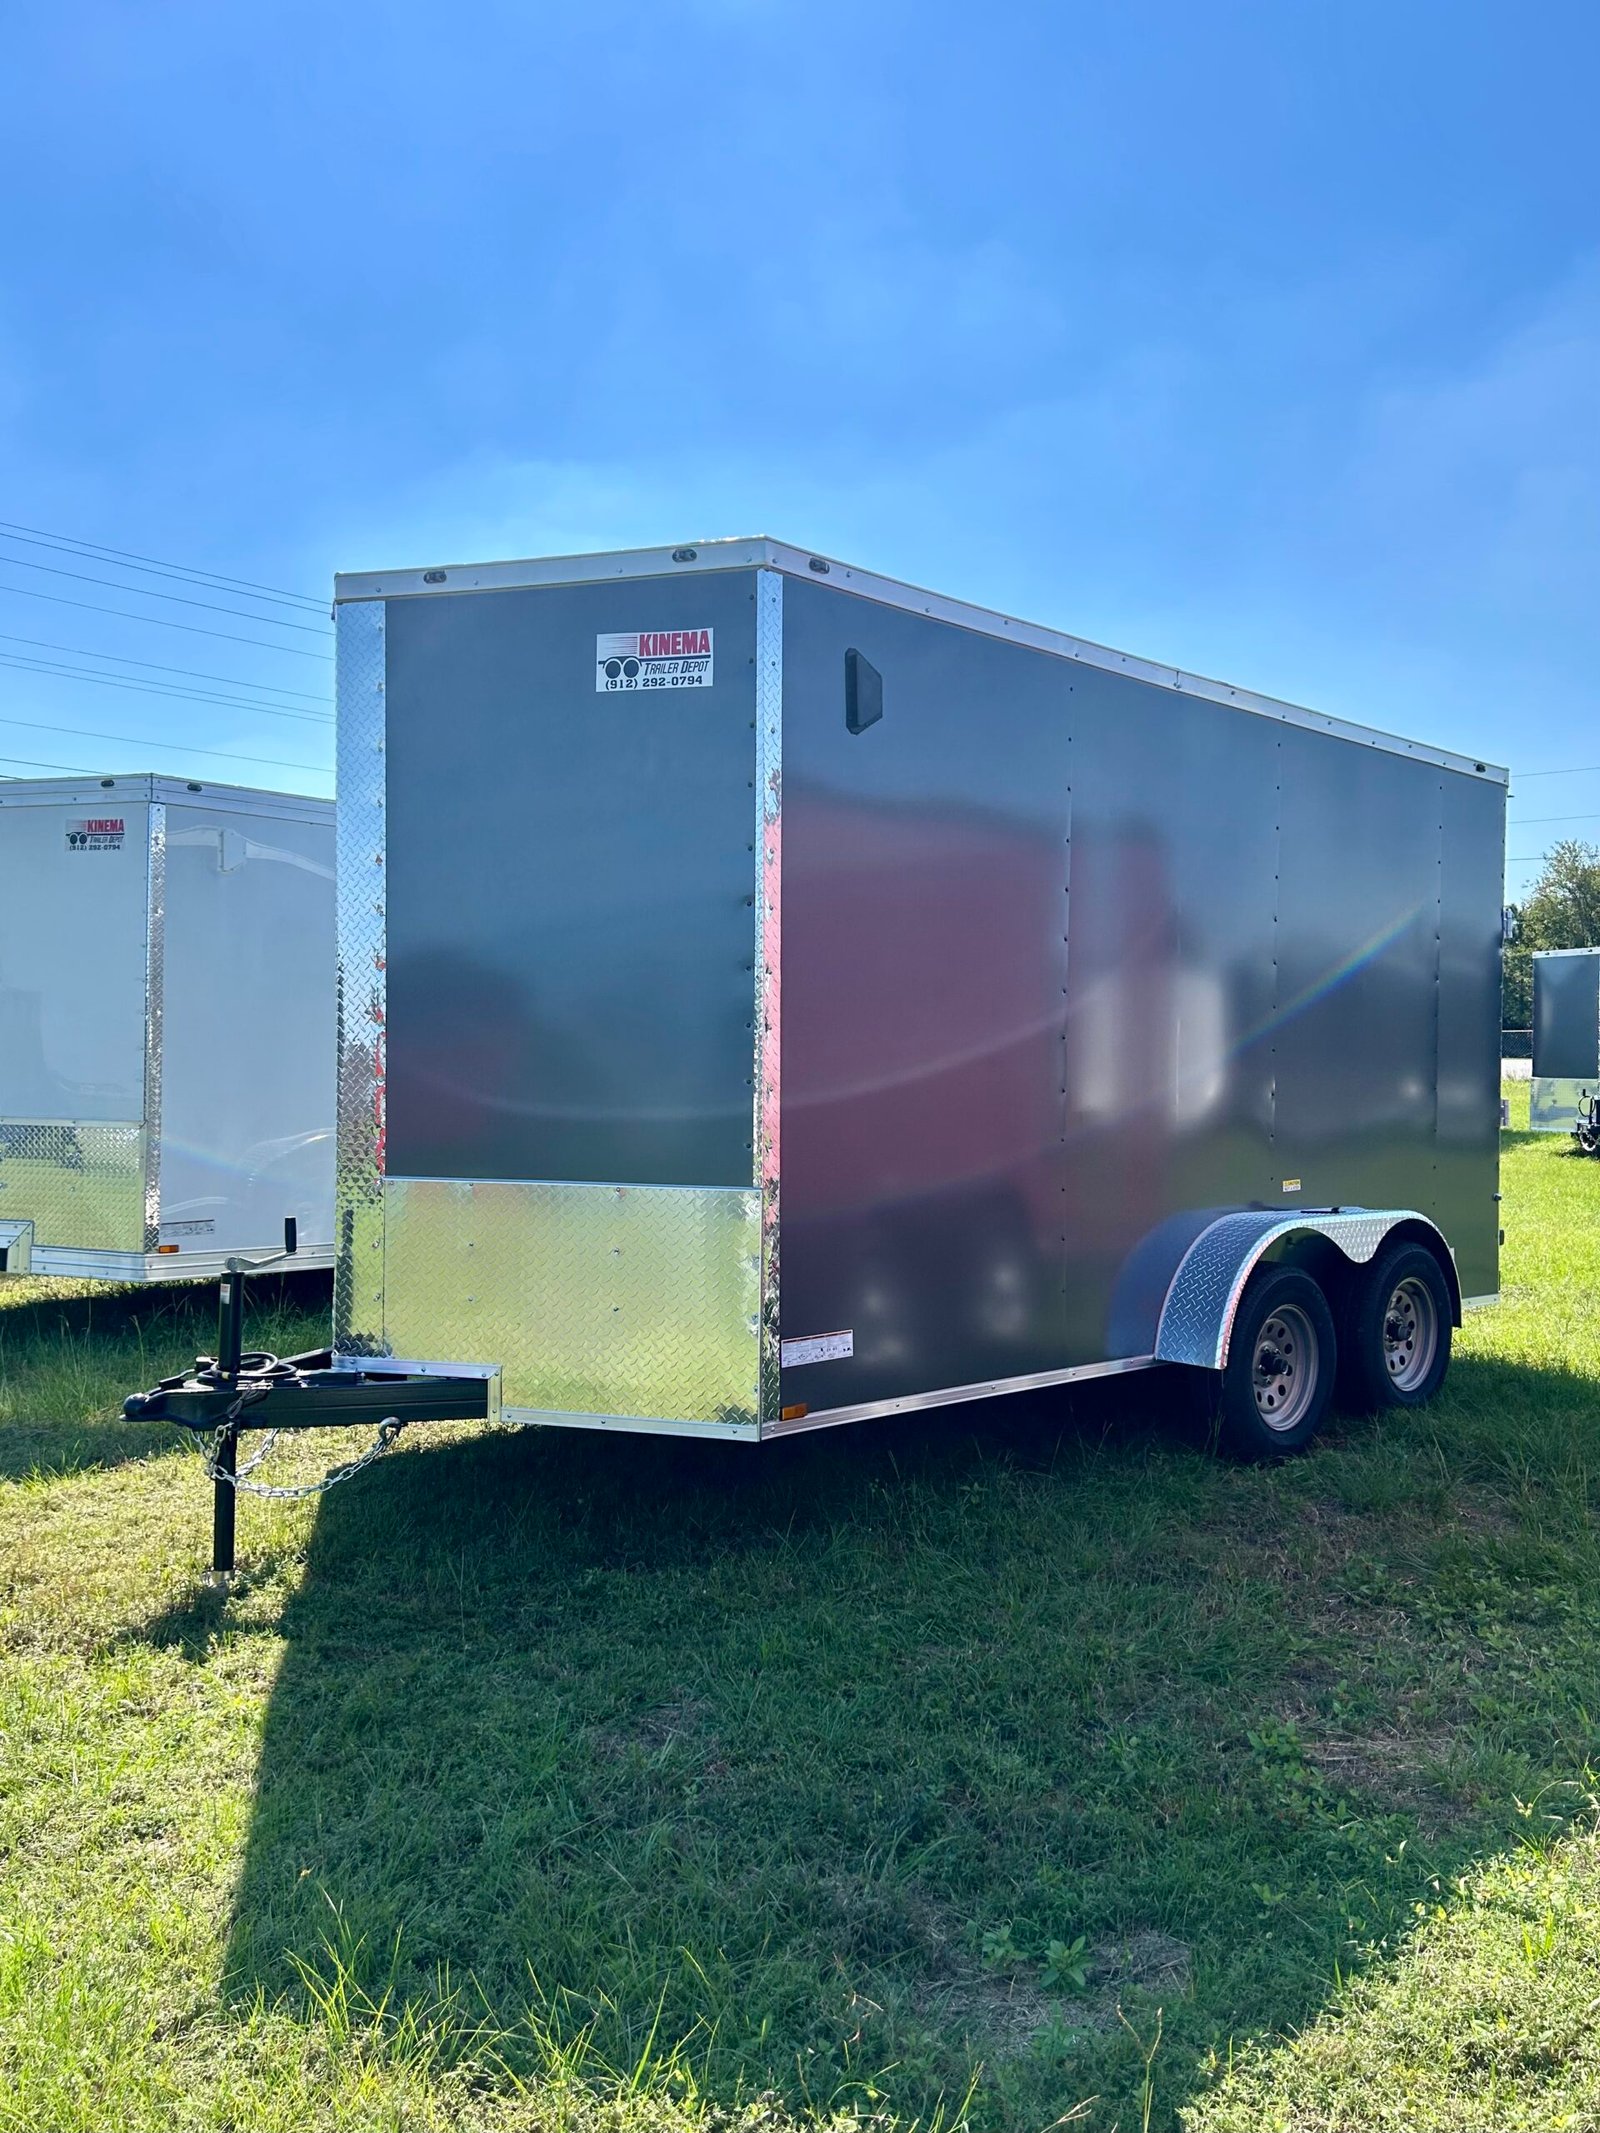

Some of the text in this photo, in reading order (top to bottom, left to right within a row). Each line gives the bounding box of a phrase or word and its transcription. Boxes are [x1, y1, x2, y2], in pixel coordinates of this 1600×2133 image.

[639, 630, 711, 657] KINEMA
[644, 660, 709, 676] TRAILER DEPOT
[605, 675, 703, 690] (912) 292-0794
[87, 819, 124, 832] KINEMA
